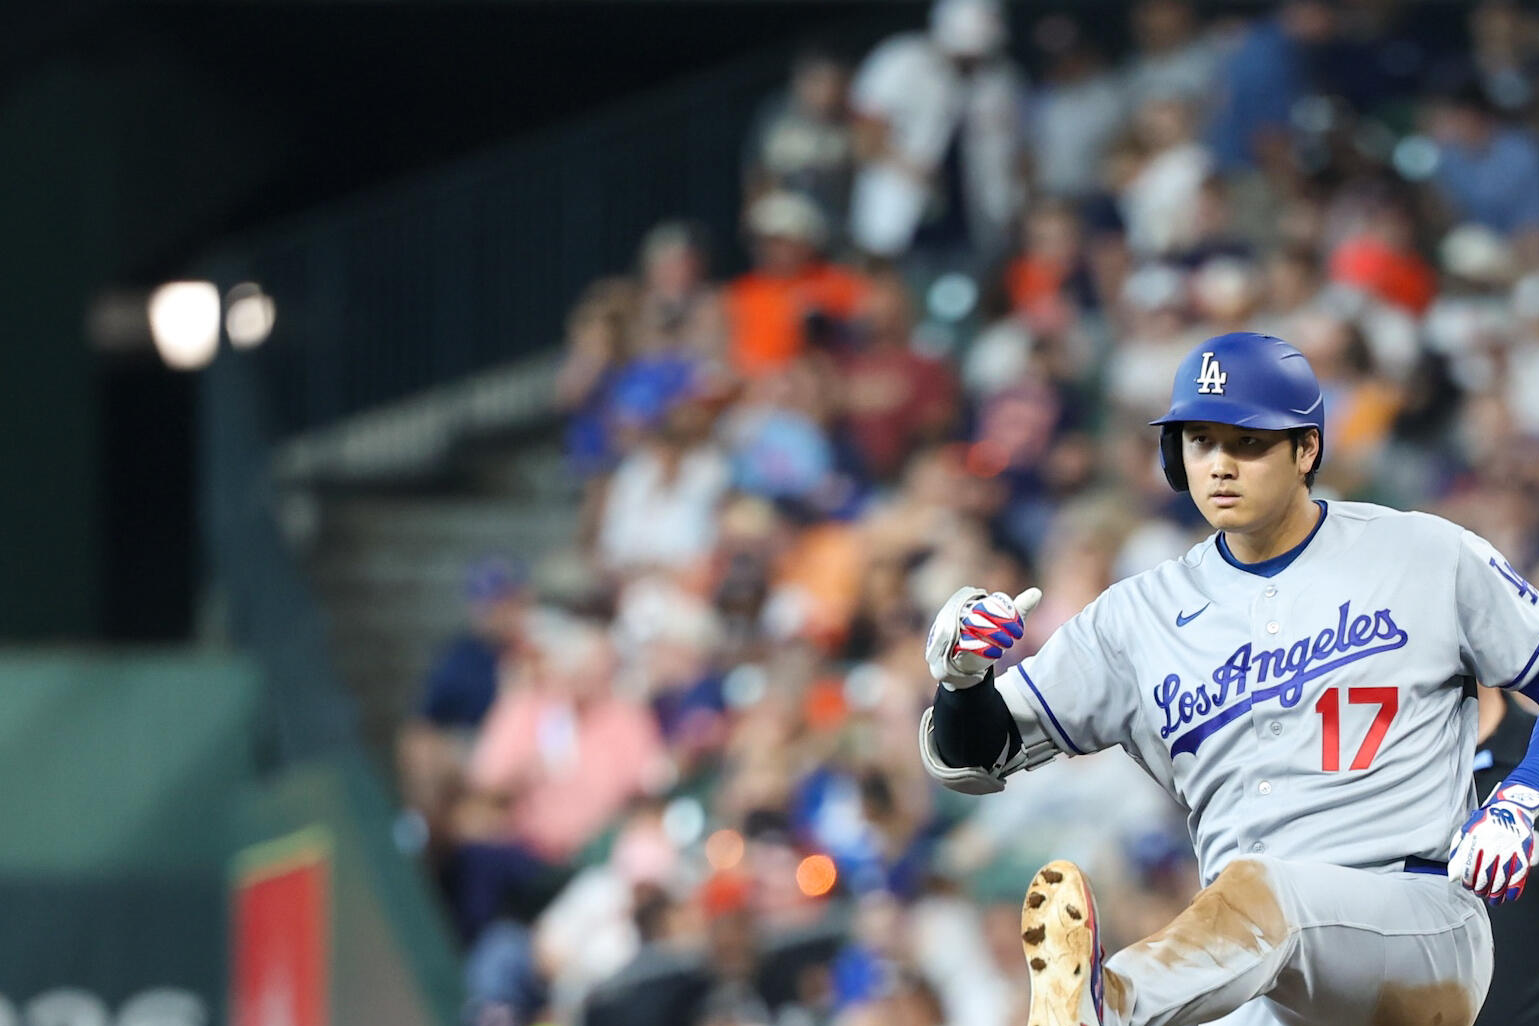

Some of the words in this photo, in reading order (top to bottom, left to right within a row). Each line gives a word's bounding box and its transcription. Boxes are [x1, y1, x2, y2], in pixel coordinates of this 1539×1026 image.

[1197, 352, 1227, 394] LA
[1154, 673, 1212, 739] Los
[1211, 600, 1408, 708] Angeles
[1315, 686, 1399, 772] 17
